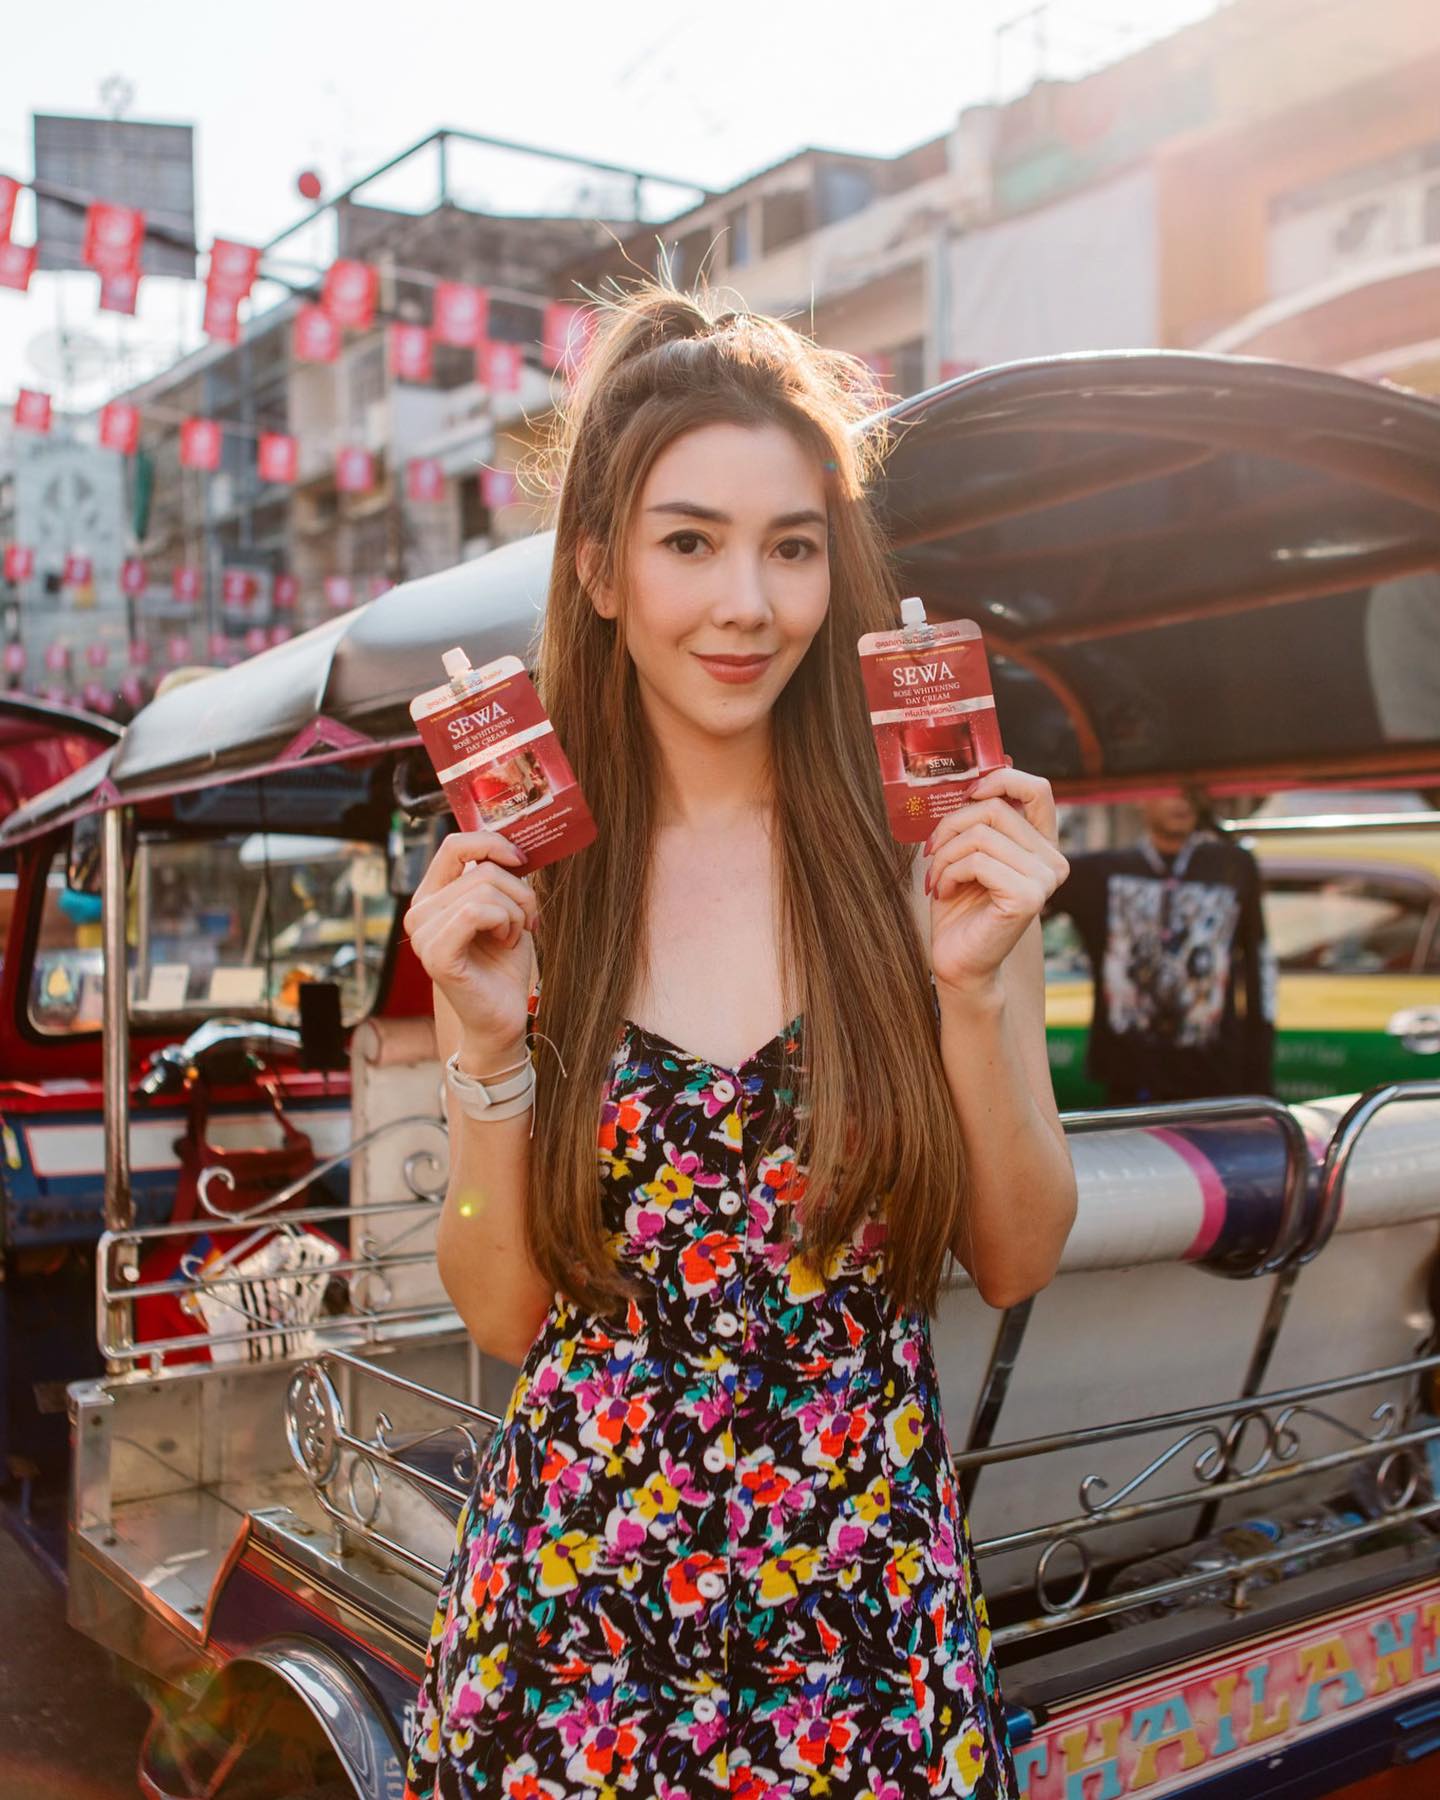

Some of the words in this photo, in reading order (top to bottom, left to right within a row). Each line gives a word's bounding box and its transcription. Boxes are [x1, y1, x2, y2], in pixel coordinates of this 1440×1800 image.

[891, 661, 955, 688] SEWA
[905, 695, 921, 705] DAY
[922, 692, 951, 704] CREAM
[912, 681, 960, 695] WHITENING
[446, 701, 508, 740] SEWA
[470, 716, 516, 742] WHITENING
[465, 741, 482, 754] DAY
[480, 728, 509, 746] CREAM
[928, 757, 956, 770] SEWA
